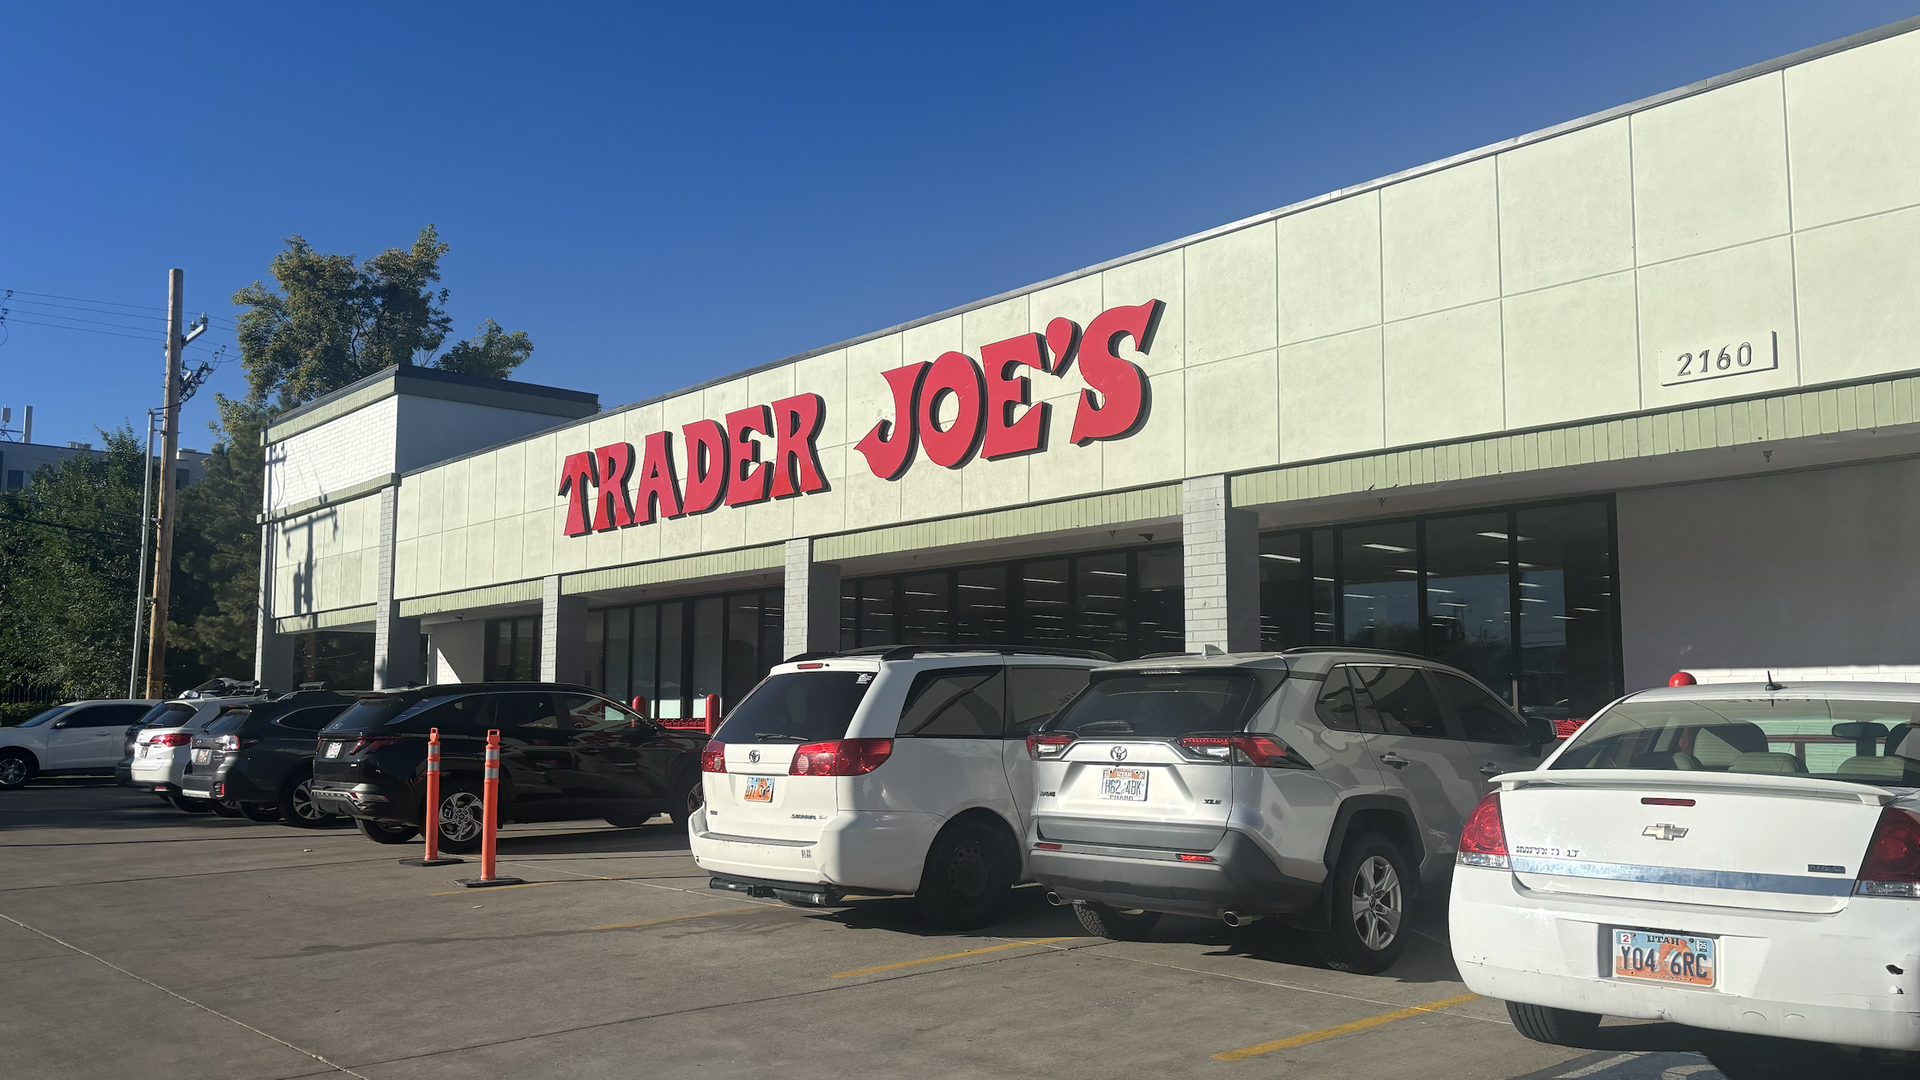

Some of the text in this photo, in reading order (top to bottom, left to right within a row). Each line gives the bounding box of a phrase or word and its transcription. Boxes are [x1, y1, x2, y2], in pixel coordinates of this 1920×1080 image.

[1677, 341, 1752, 376] 2160
[558, 299, 1166, 538] TRADER JOE'S
[1105, 779, 1142, 796] H62 4BK
[1622, 934, 1630, 943] 2
[1646, 935, 1680, 946] UTAH
[1620, 945, 1707, 978] Y04 6RC
